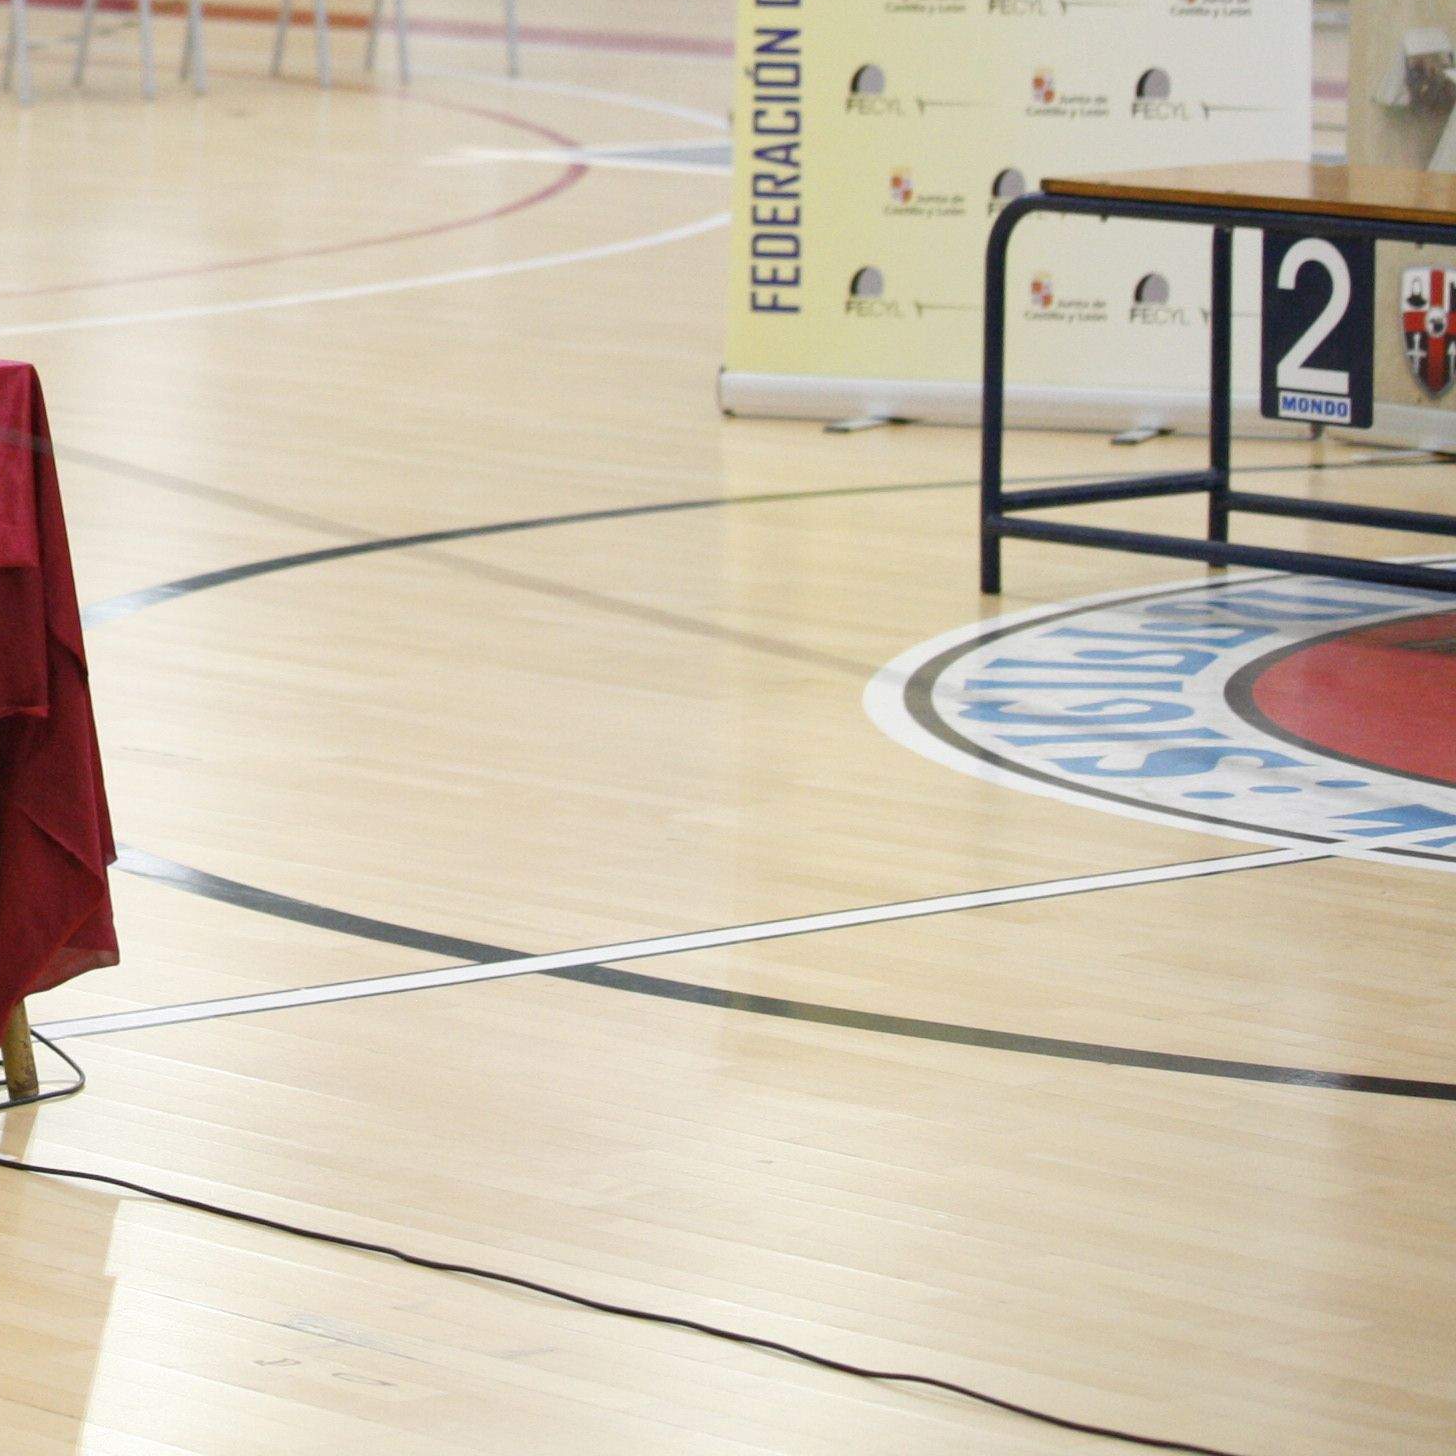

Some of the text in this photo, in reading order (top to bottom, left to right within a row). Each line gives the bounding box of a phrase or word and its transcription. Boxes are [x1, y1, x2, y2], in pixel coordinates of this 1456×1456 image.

[746, 28, 802, 313] FEDERACIÓN
[1277, 237, 1352, 395] 2
[1281, 395, 1349, 416] MONDO
